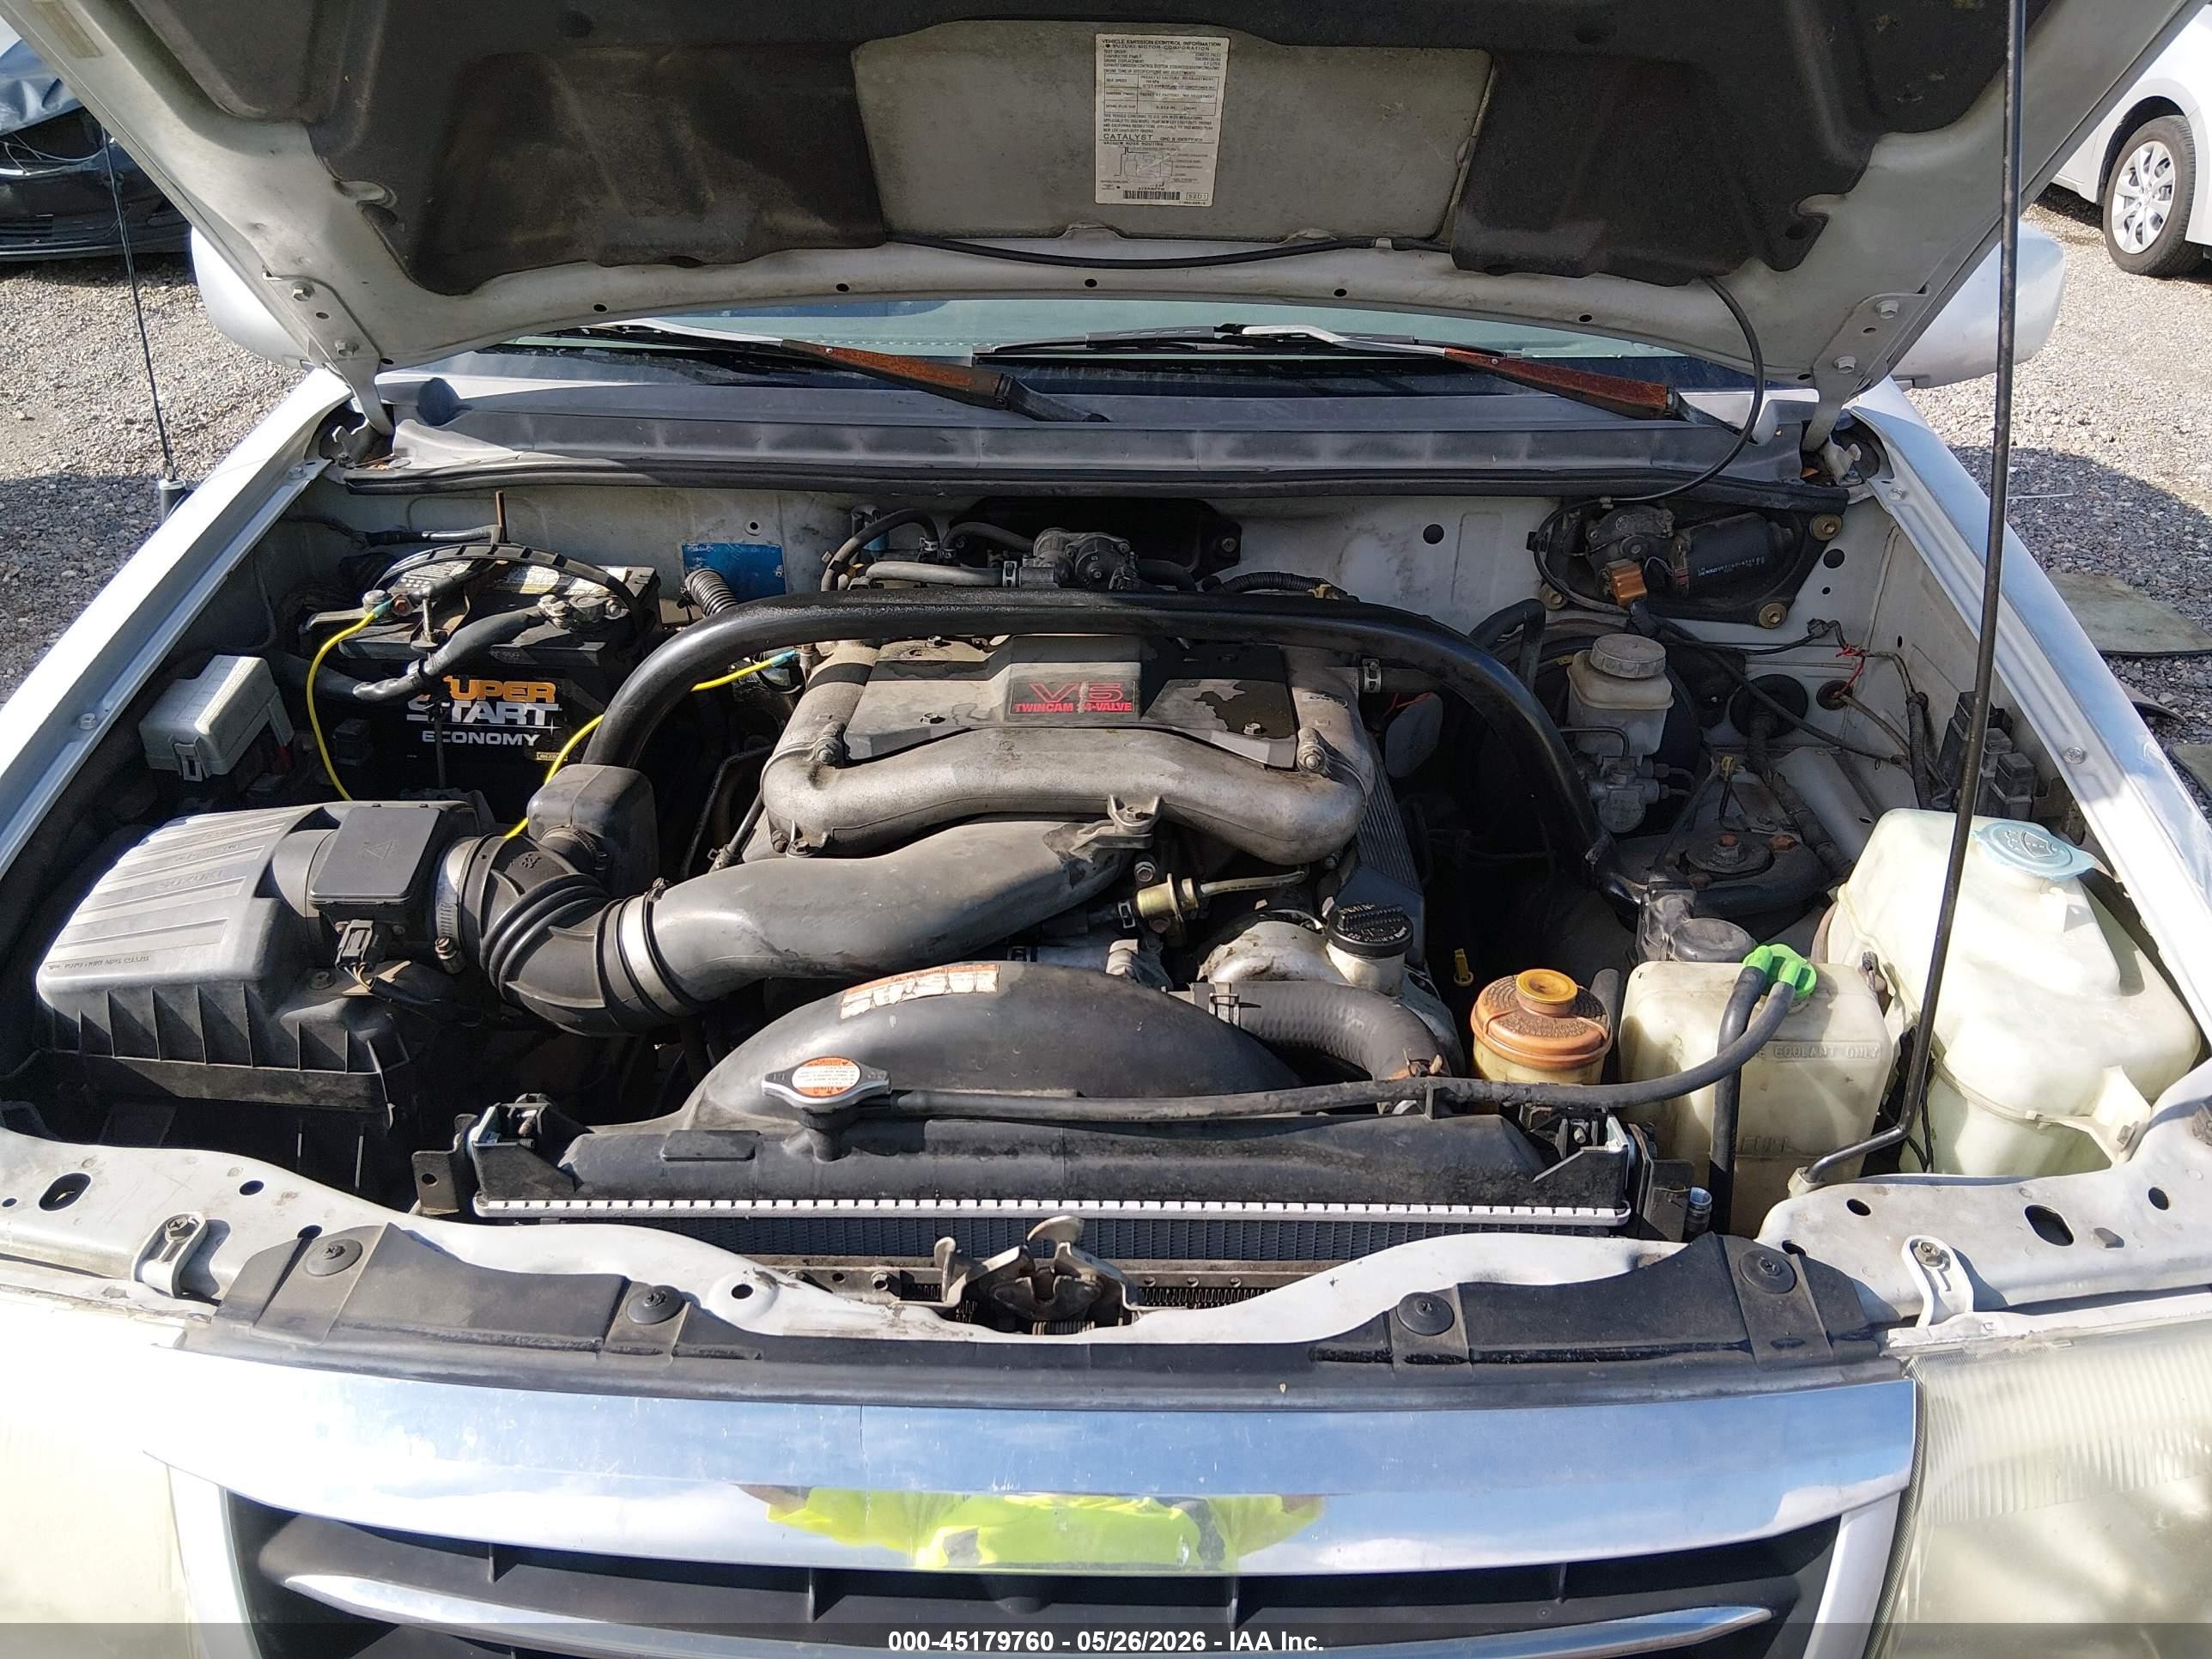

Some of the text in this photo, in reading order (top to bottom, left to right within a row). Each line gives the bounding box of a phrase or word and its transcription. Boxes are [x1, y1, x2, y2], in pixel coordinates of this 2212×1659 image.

[443, 676, 556, 703] UPER
[1015, 702, 1073, 713] TWINCAM
[1773, 1044, 1835, 1059] COOLANT
[1845, 1044, 1879, 1059] ONLY
